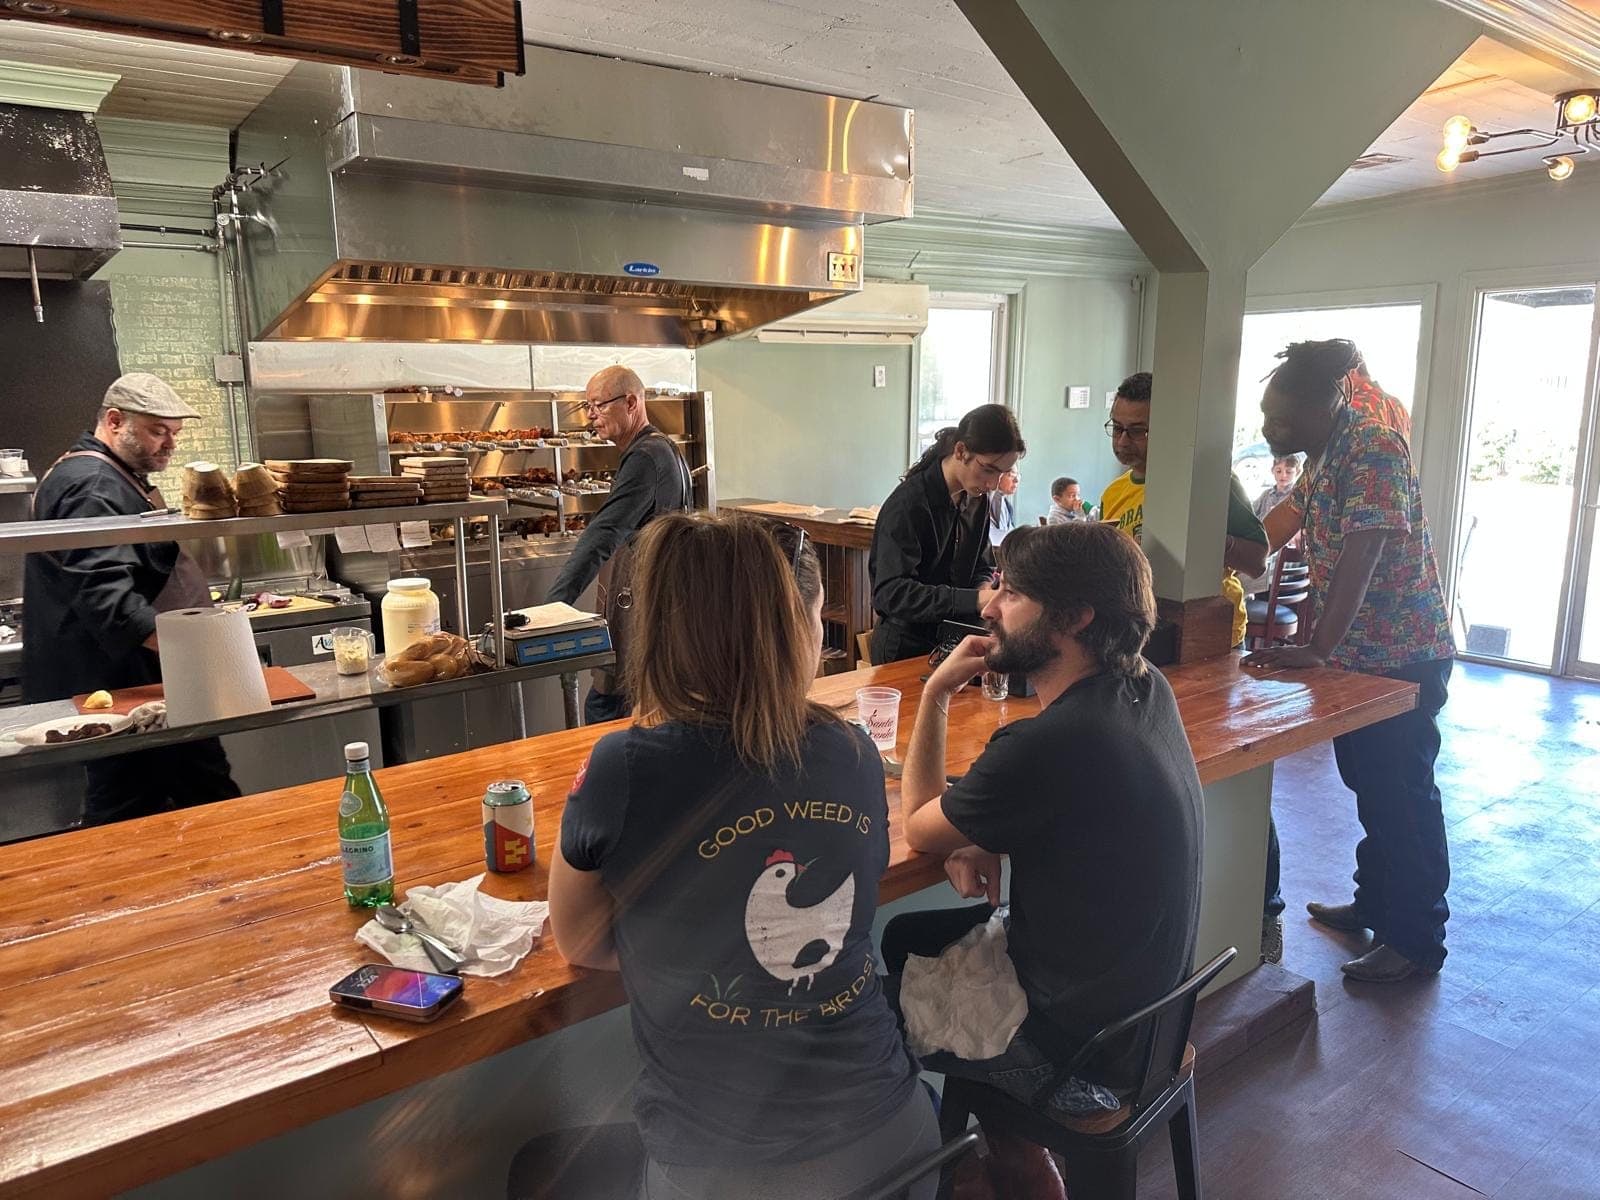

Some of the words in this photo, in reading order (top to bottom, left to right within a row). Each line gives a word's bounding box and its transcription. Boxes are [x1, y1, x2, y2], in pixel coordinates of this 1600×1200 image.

[698, 807, 775, 859] GOOD
[783, 800, 853, 824] WEED
[855, 812, 872, 835] IS
[690, 992, 751, 1026] FOR
[760, 1007, 811, 1028] THE
